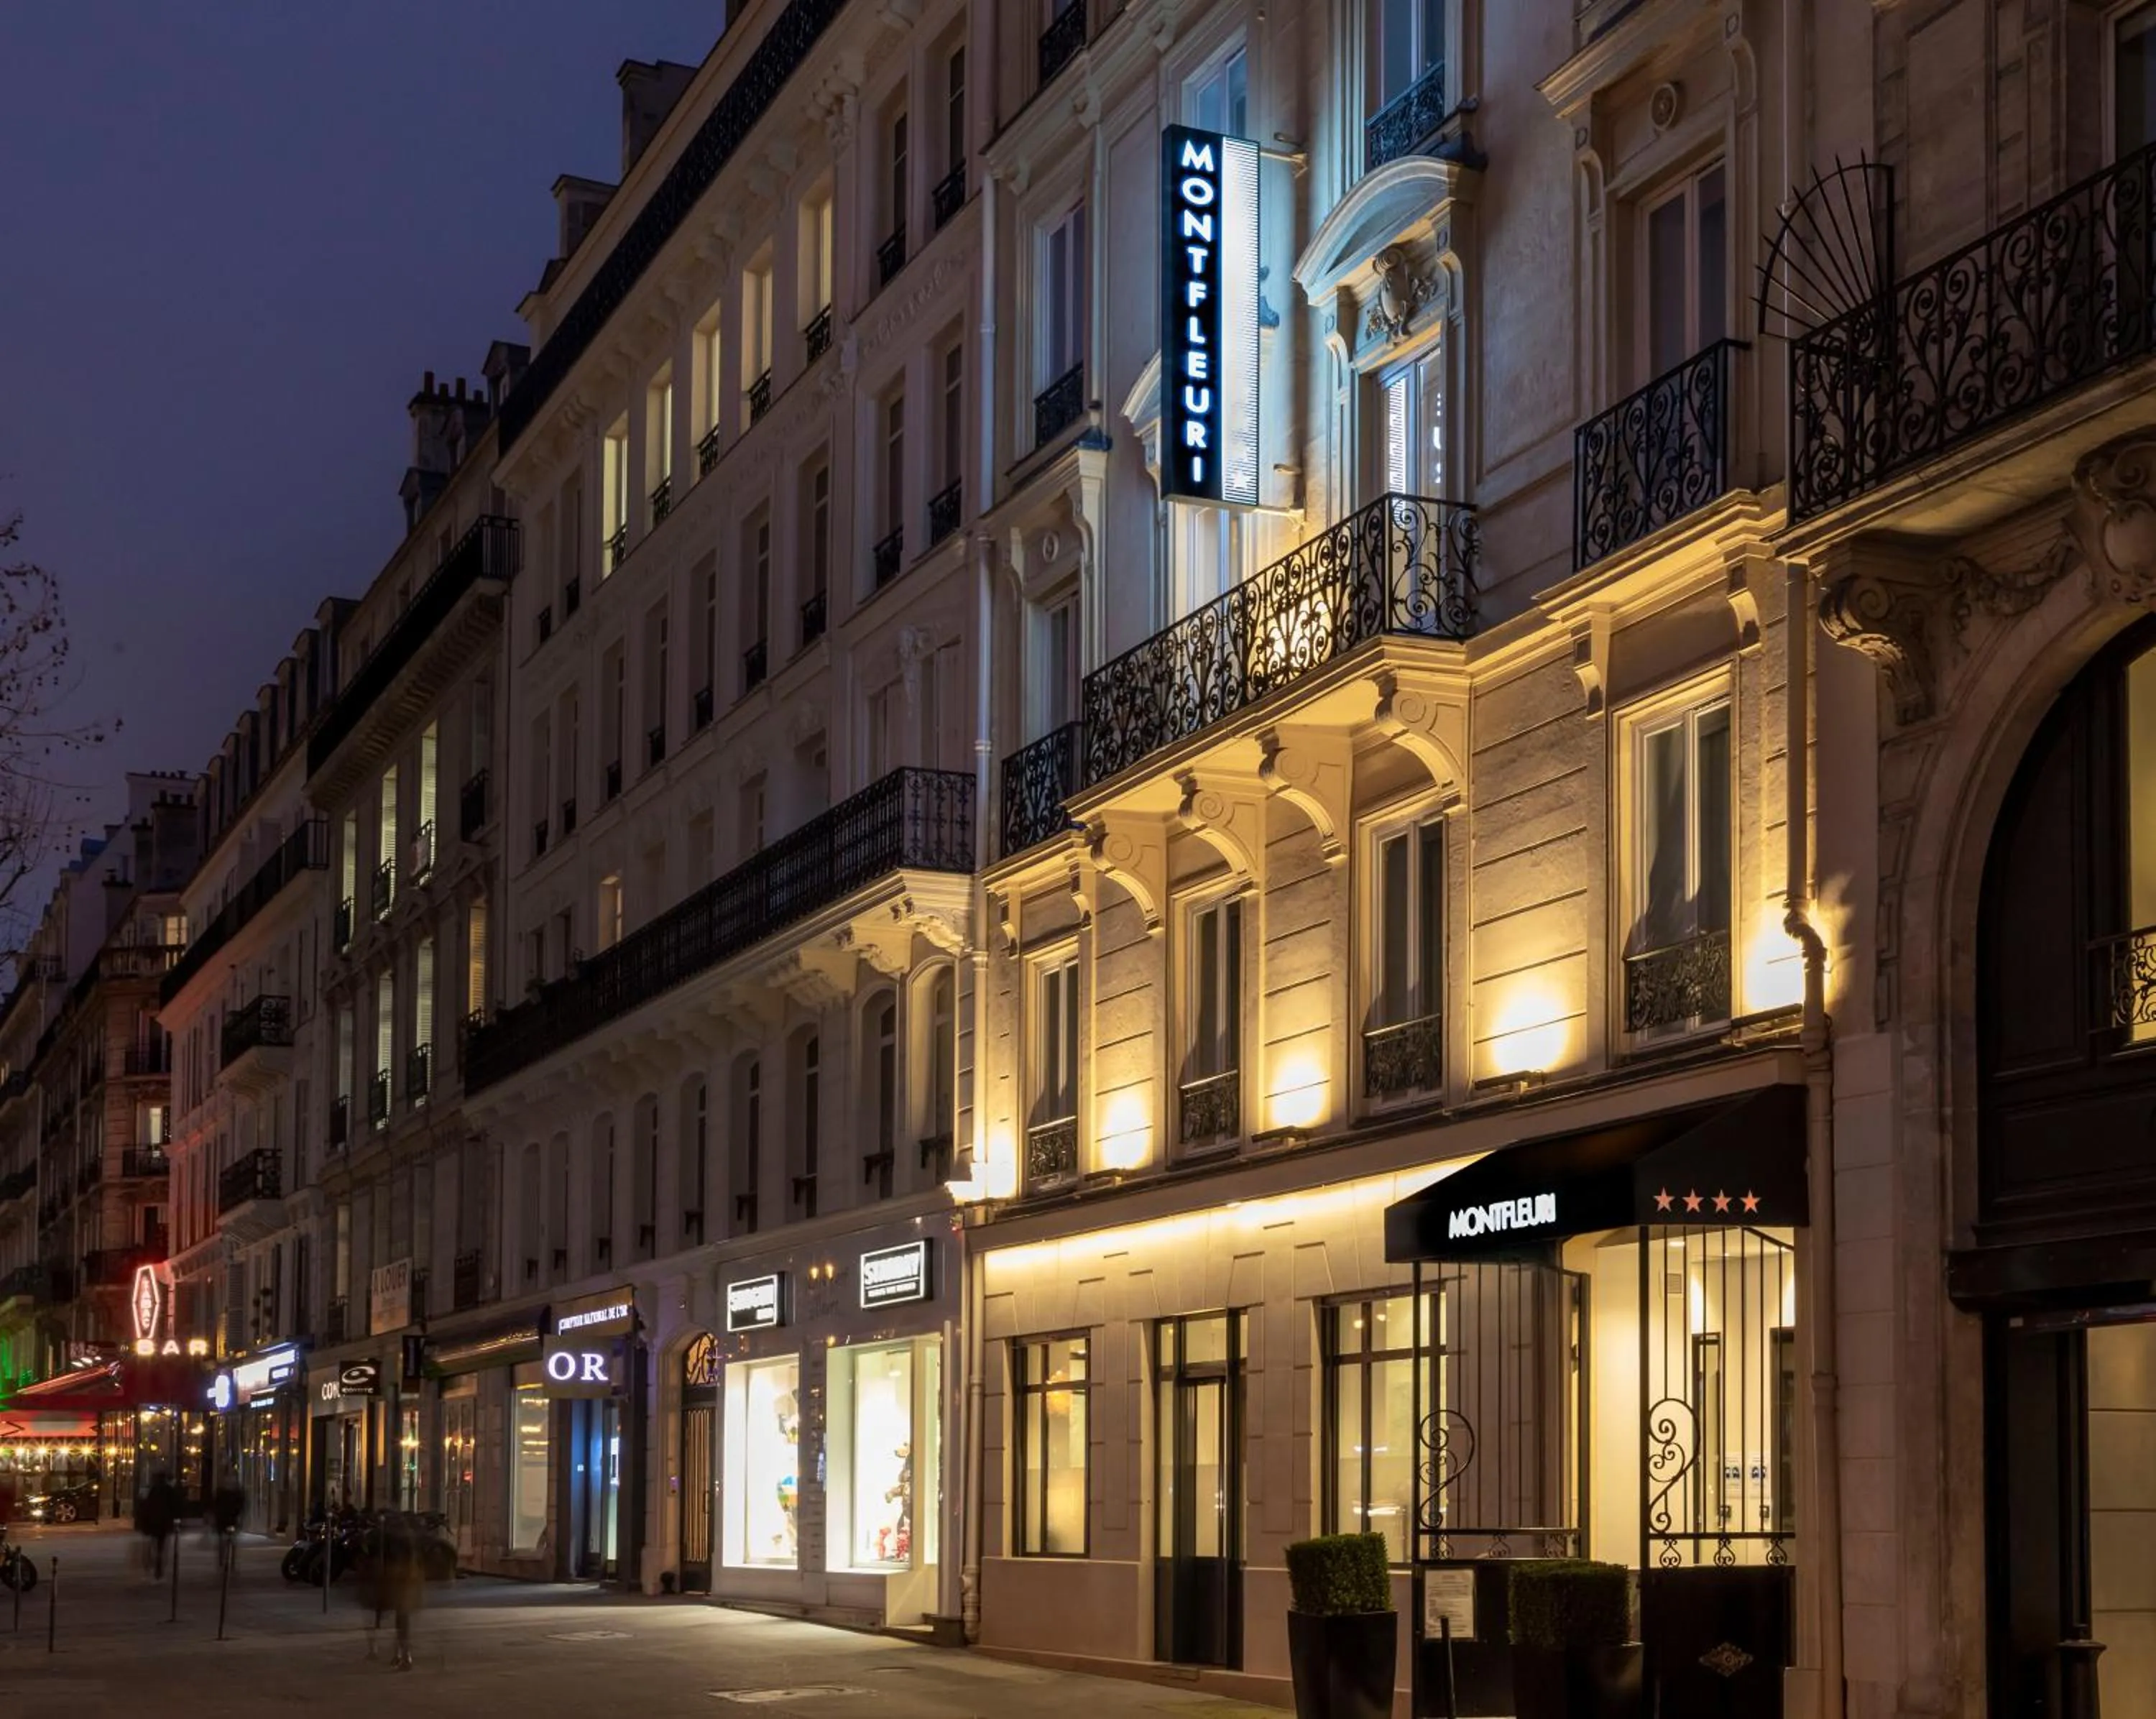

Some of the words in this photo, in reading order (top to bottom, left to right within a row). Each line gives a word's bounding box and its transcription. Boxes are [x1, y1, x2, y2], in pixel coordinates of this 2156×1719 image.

[1180, 139, 1215, 484] MONTFLEURI
[137, 1339, 207, 1355] BAR
[548, 1352, 609, 1381] OR
